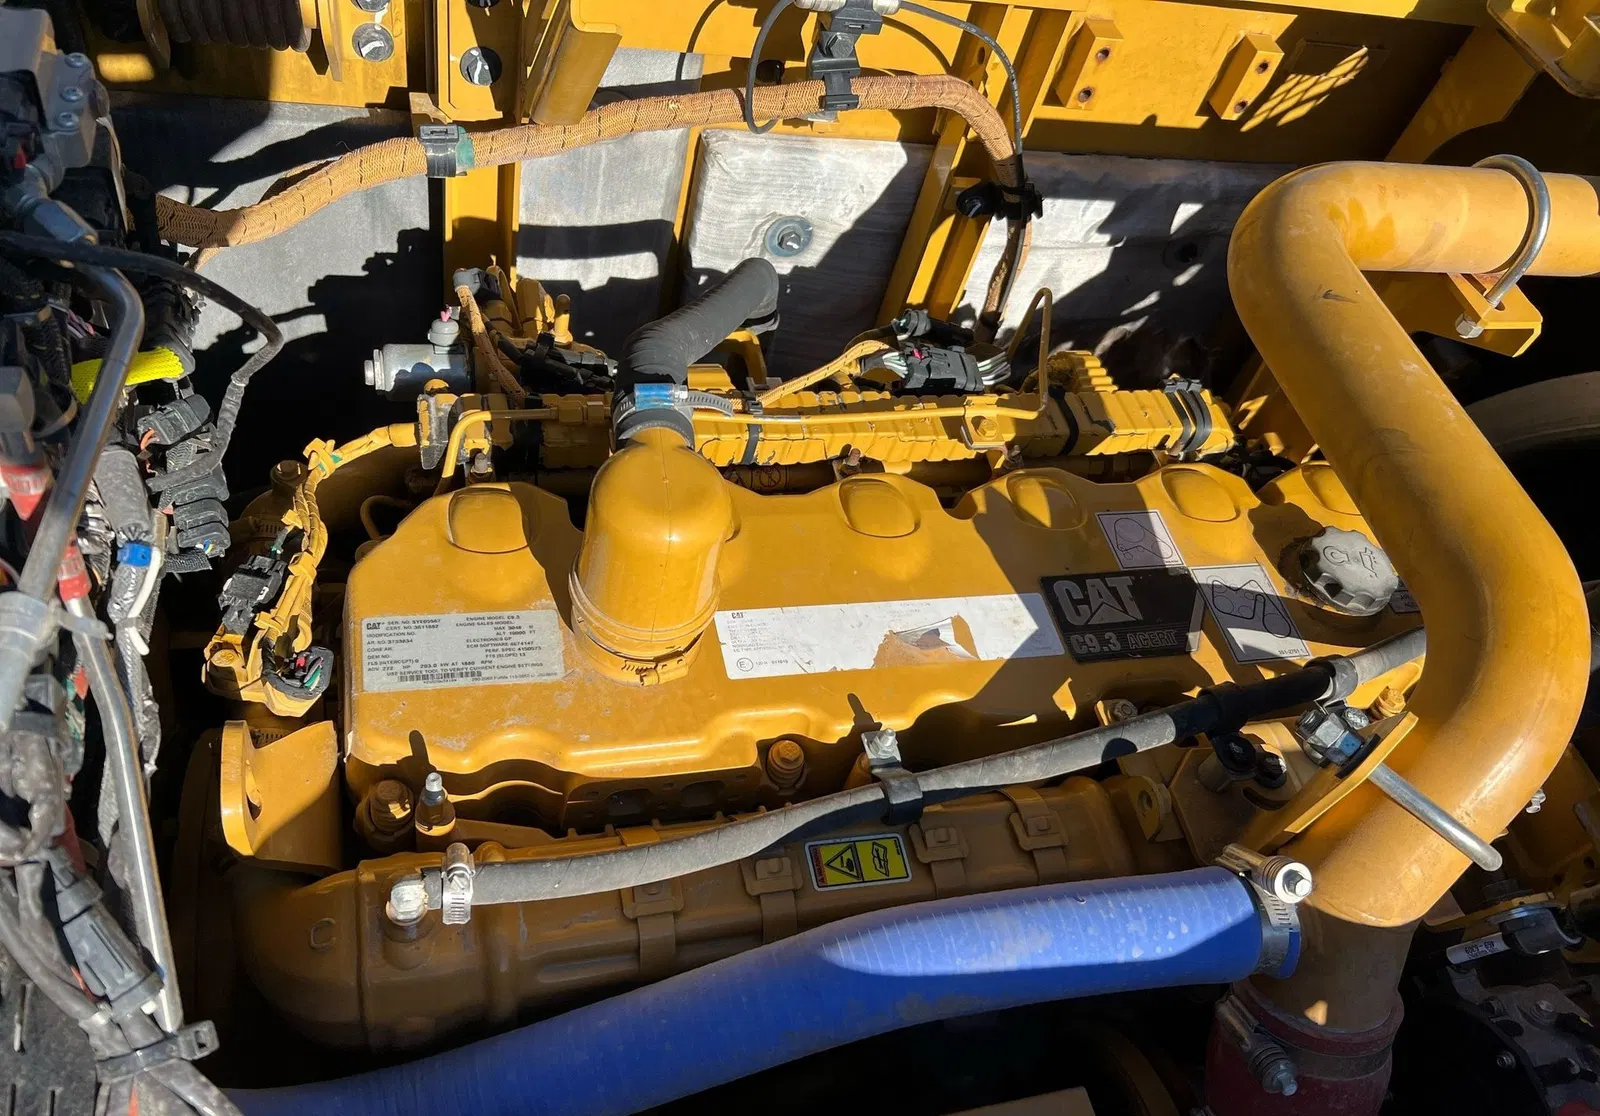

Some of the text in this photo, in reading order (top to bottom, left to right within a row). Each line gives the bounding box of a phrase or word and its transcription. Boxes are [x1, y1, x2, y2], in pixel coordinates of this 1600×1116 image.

[1053, 576, 1143, 625] CAT
[1070, 630, 1178, 654] C9.3 ACERT
